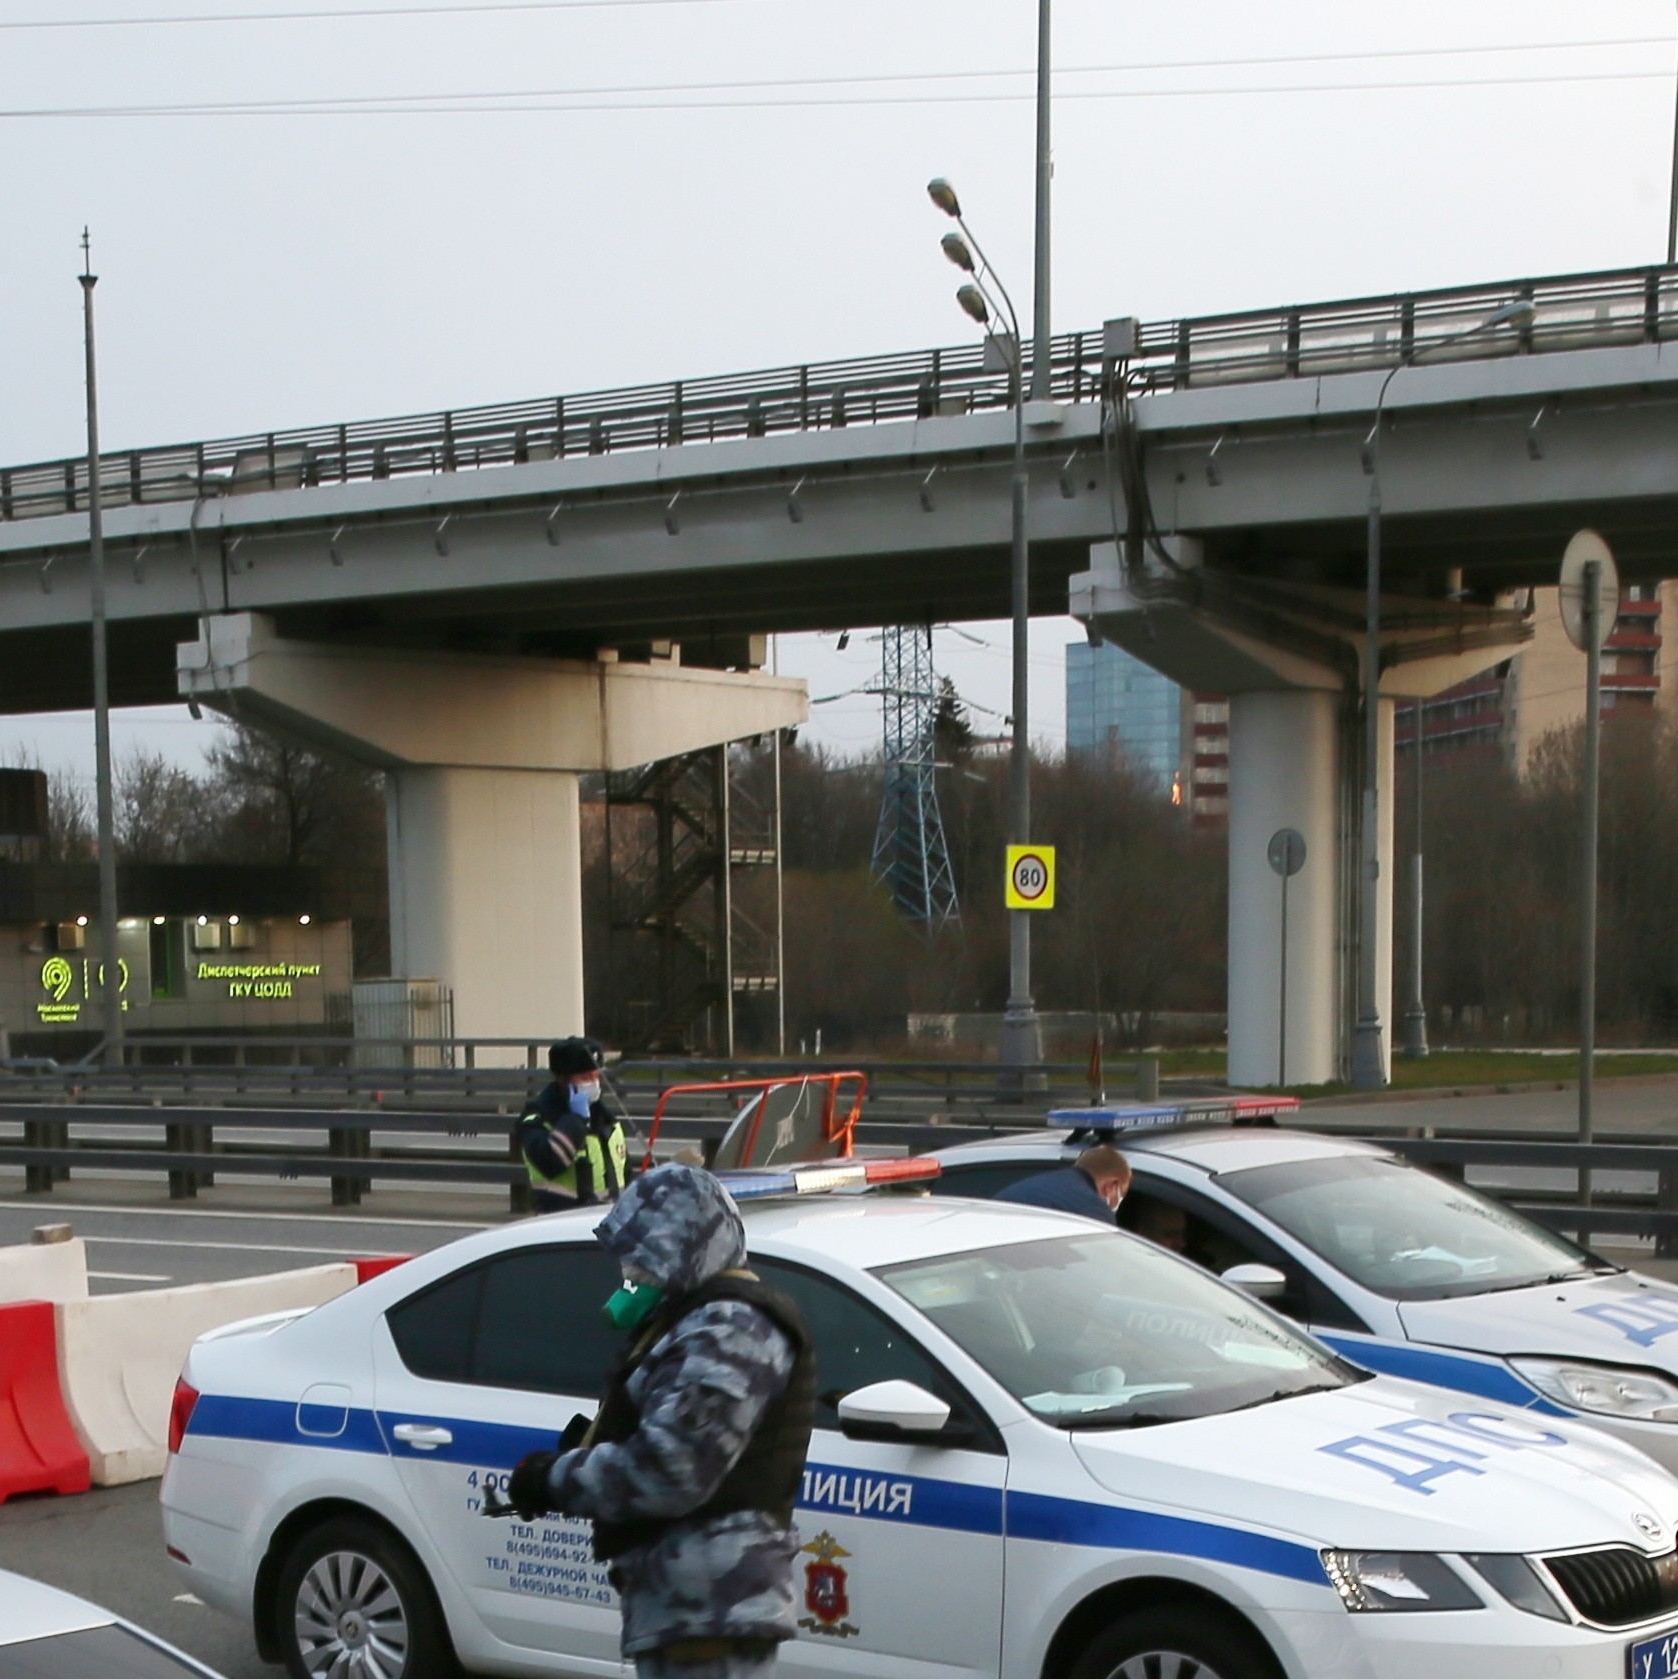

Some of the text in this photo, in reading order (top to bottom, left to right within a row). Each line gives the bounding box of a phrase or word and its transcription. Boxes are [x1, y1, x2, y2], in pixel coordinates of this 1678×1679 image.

[1019, 868, 1041, 887] 80
[197, 962, 321, 980] Диспетчерский пункт
[229, 982, 292, 997] ГКУ ЦОДД
[1314, 1411, 1569, 1497] ДПС
[467, 1471, 478, 1489] 4
[467, 1497, 481, 1511] ГУ
[510, 1524, 593, 1547] ТЕЛ. ДОВЕРИ
[485, 1556, 513, 1571] ТЕЛ.
[517, 1561, 588, 1582] ДЕЖУРНОЙ
